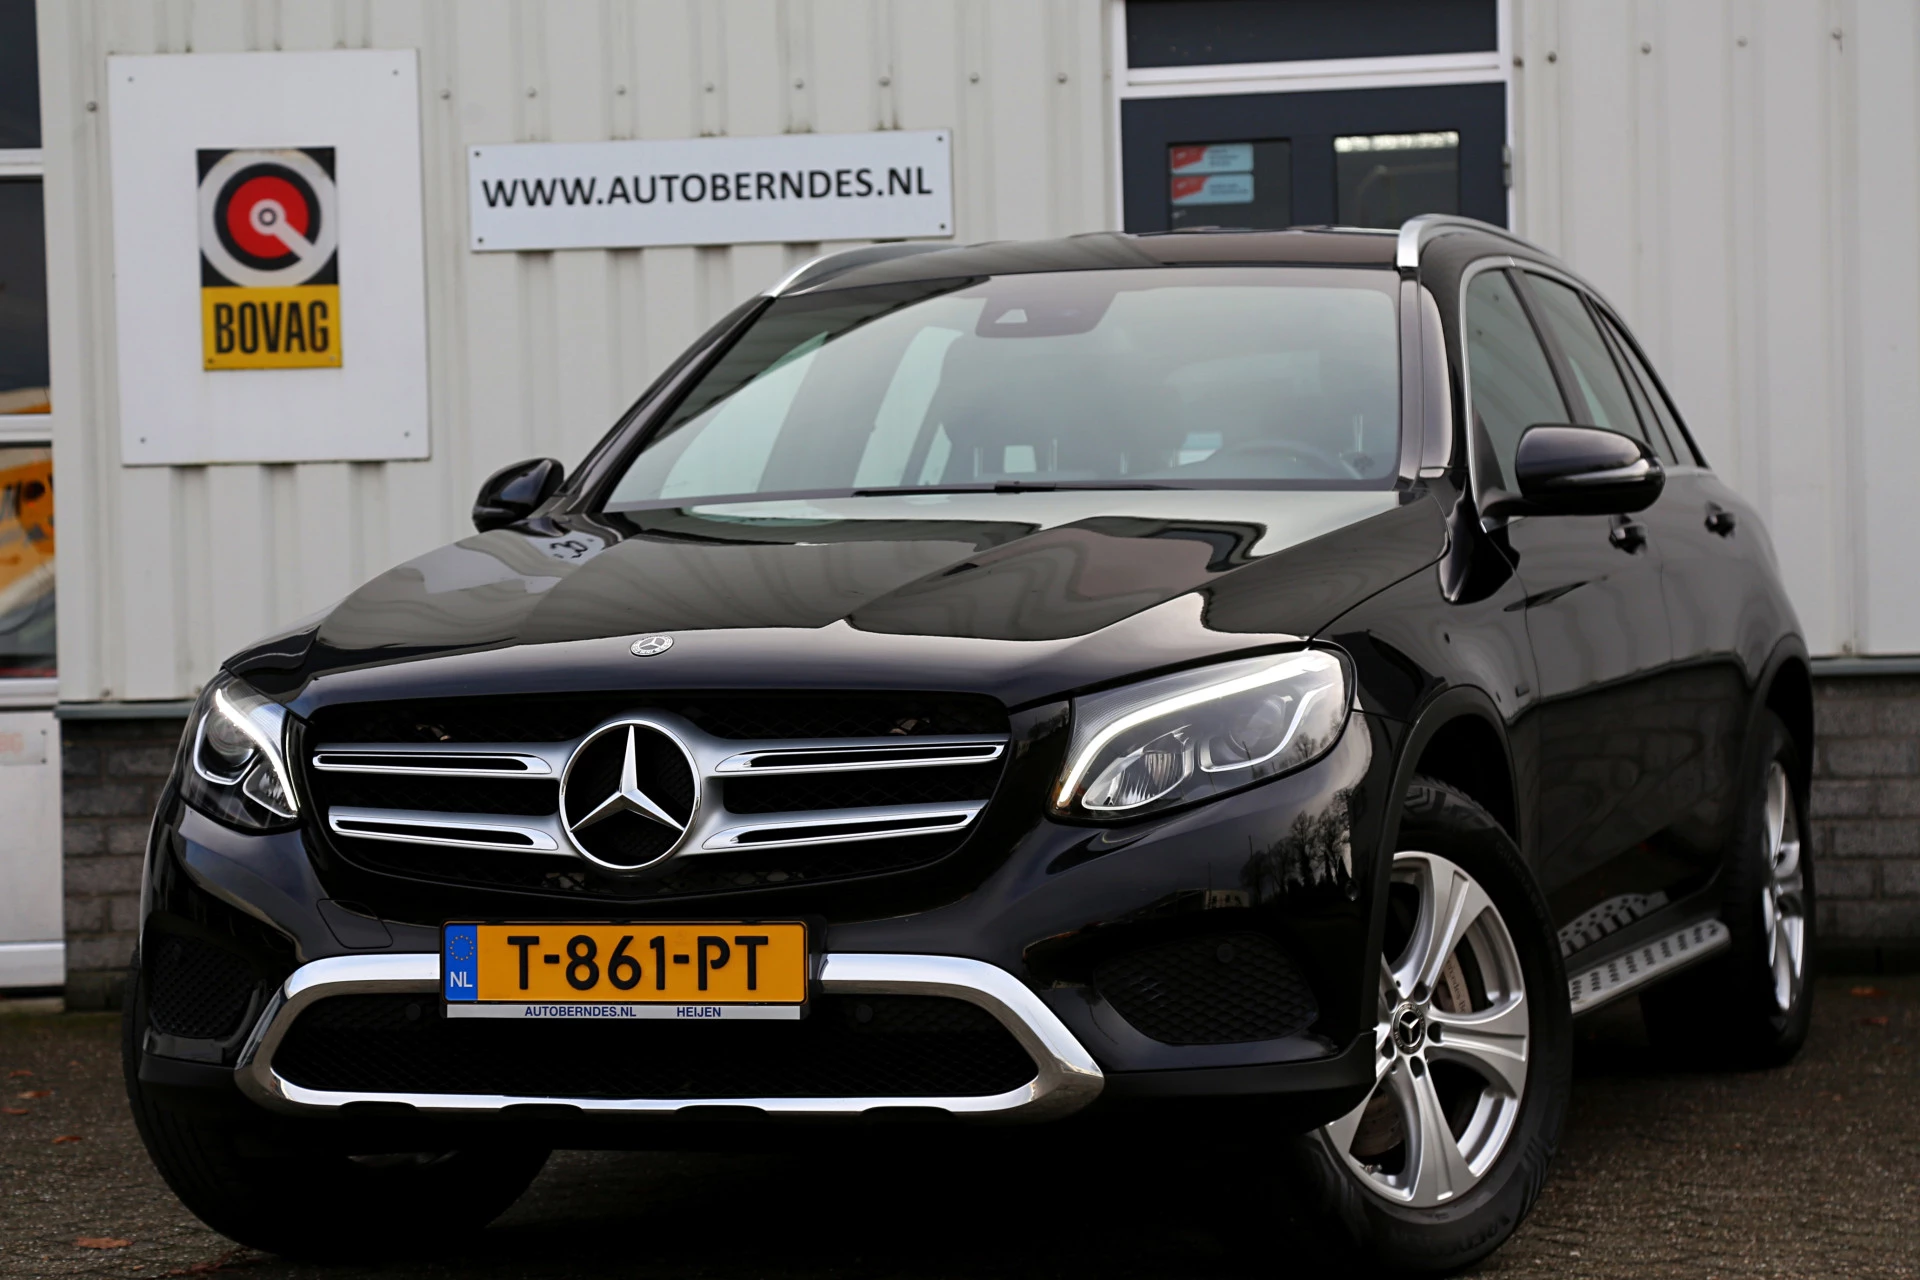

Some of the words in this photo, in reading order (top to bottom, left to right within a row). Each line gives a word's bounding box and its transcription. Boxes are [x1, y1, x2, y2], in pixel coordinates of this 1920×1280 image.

[482, 166, 933, 207] WWW.AUTOBERNDES.NL
[214, 300, 329, 354] BOVAG
[450, 971, 473, 988] NL
[507, 935, 768, 991] T-861-PT
[525, 1006, 637, 1017] AUTOBERNDES.NL
[676, 1007, 721, 1018] HEIJEN
